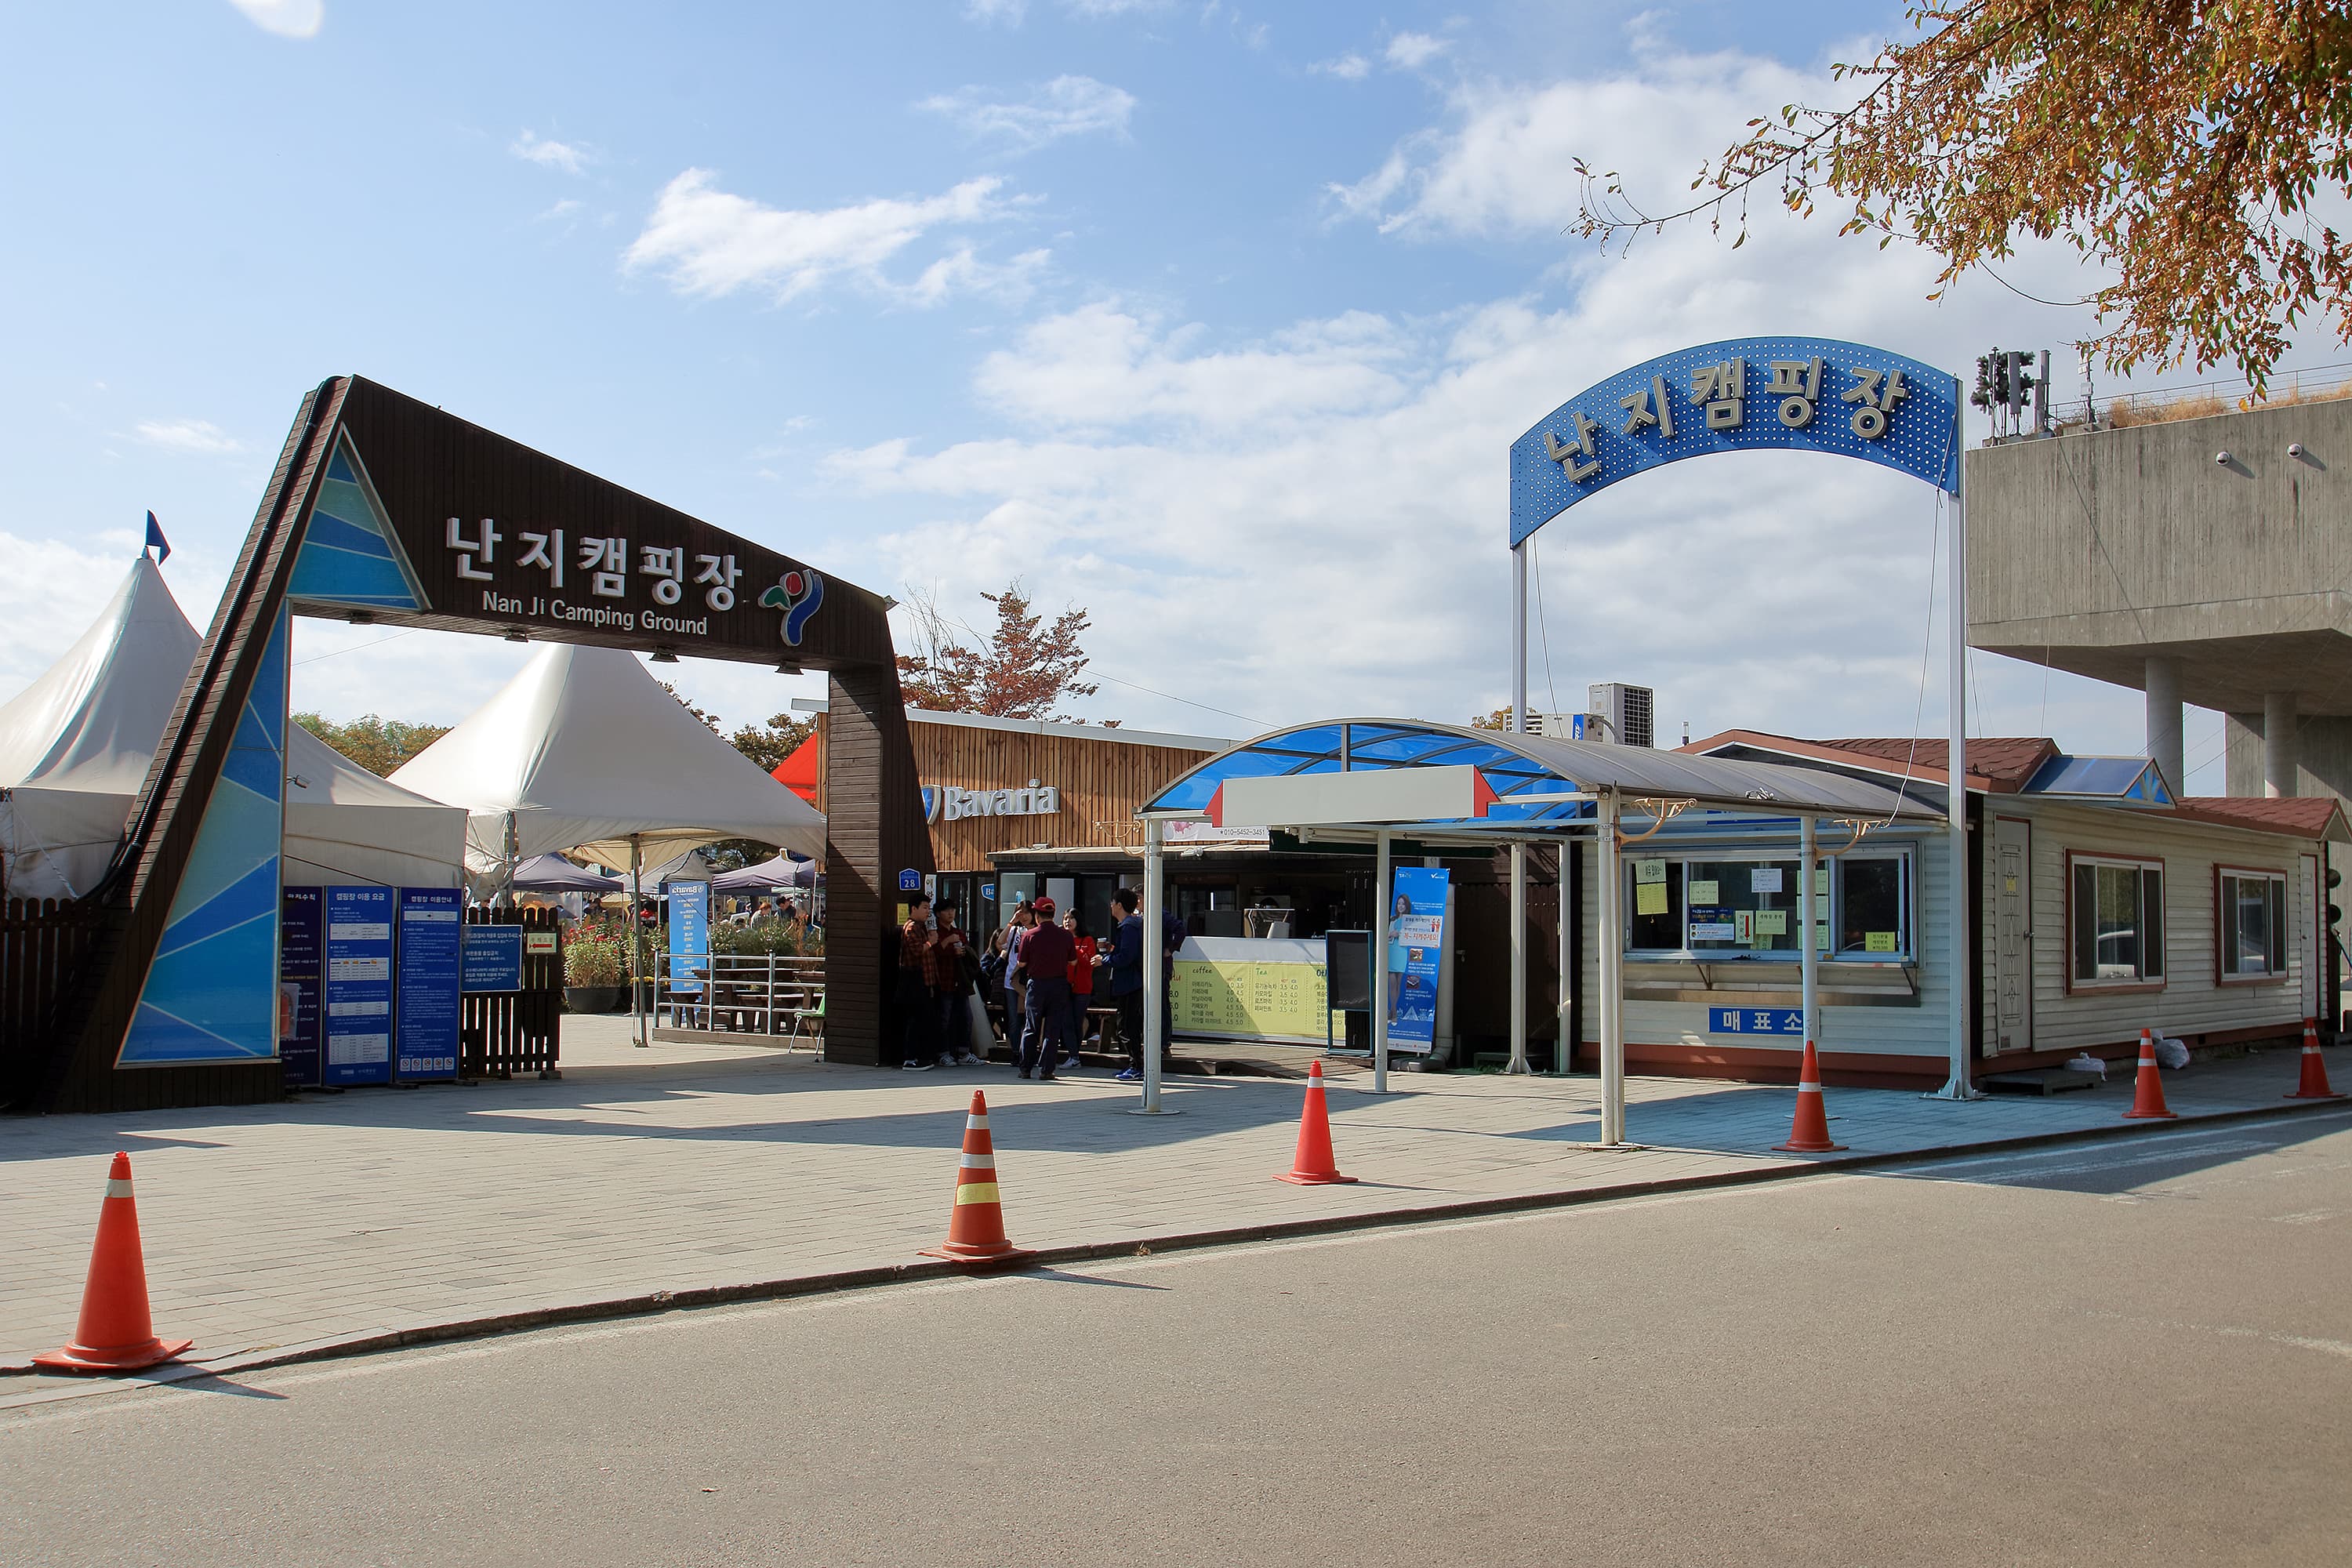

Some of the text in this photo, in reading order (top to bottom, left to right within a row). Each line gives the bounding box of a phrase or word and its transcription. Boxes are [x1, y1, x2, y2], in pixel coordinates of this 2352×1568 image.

[1542, 357, 1909, 484] 난지캠핑장
[445, 517, 743, 612] 난지캠핑장
[482, 590, 708, 637] Nan Ji Camping Ground
[942, 779, 1061, 822] Bavaria
[904, 879, 916, 888] 28
[1722, 1010, 1803, 1032] 매표소
